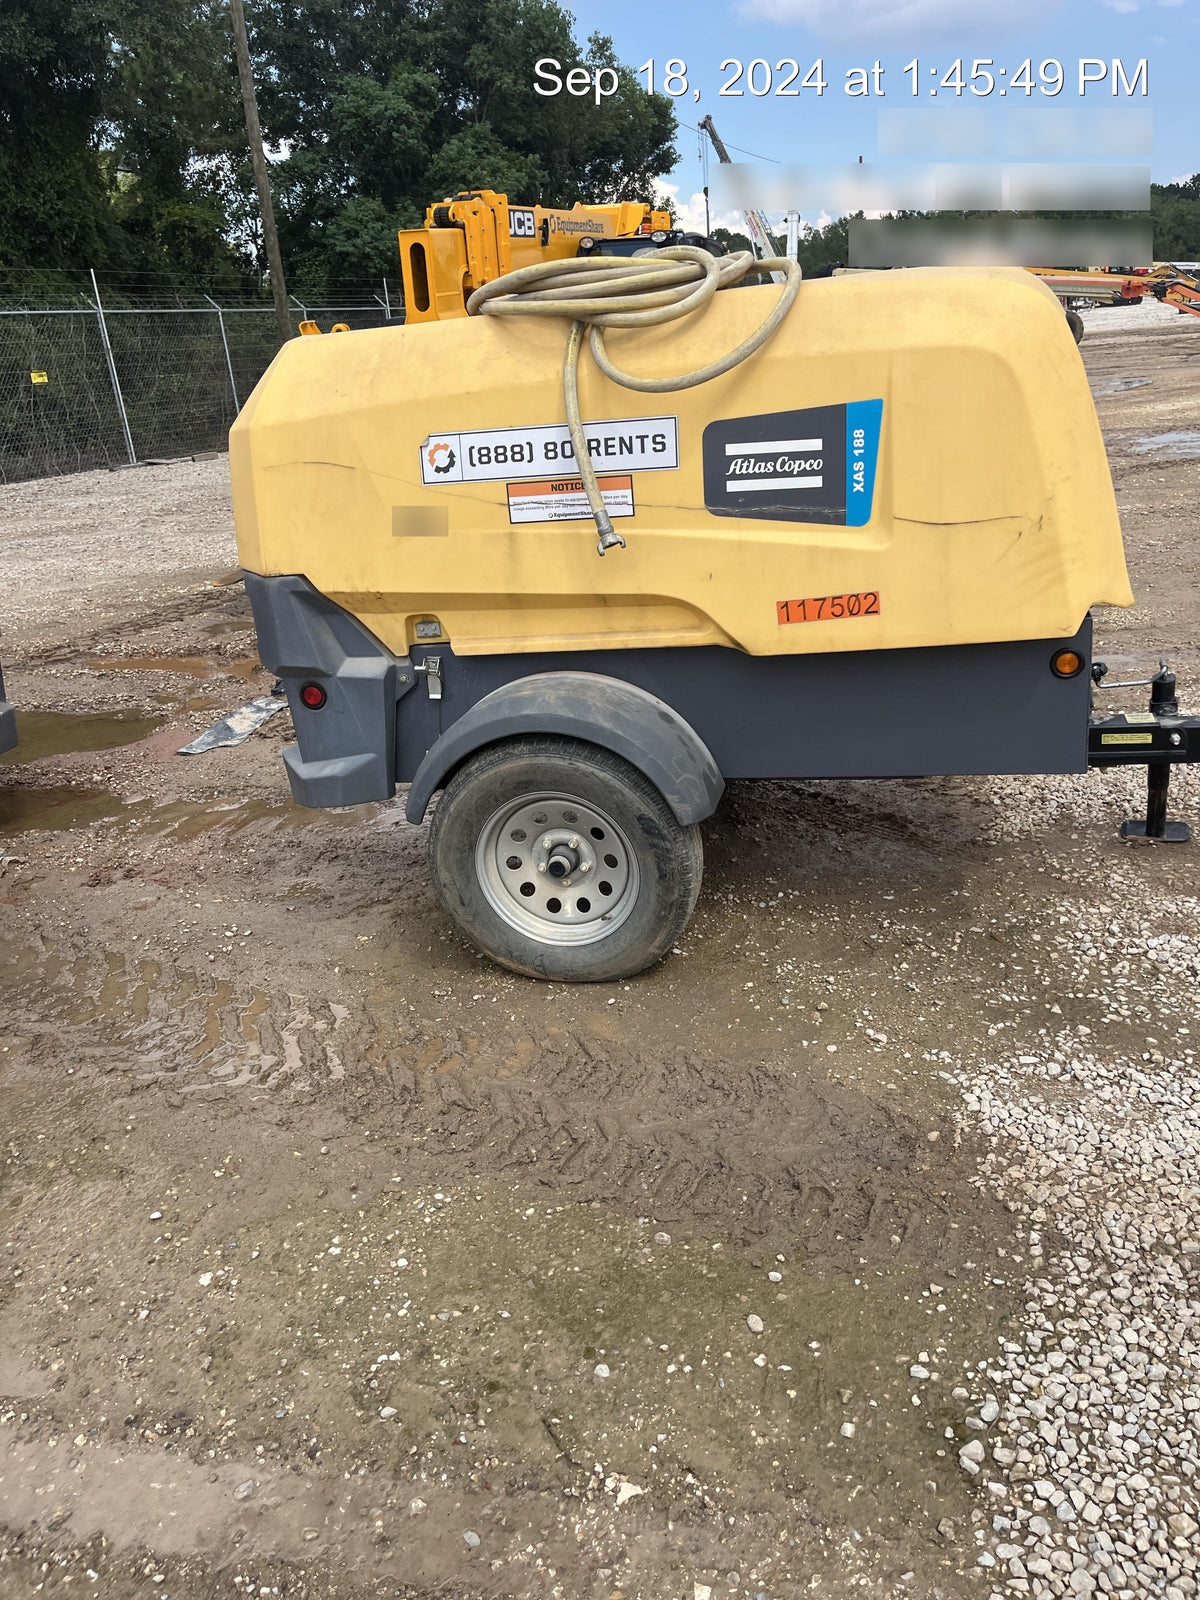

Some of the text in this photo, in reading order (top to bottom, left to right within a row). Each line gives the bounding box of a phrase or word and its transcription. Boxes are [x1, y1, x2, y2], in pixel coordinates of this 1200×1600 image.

[509, 211, 535, 236] JCB
[556, 216, 604, 235] EquipmentShare
[468, 442, 534, 467] (888)
[725, 455, 824, 476] Atlas Copco
[853, 428, 865, 493] XAS 188
[554, 510, 593, 518] EquipmentShar
[780, 592, 879, 622] 117502
